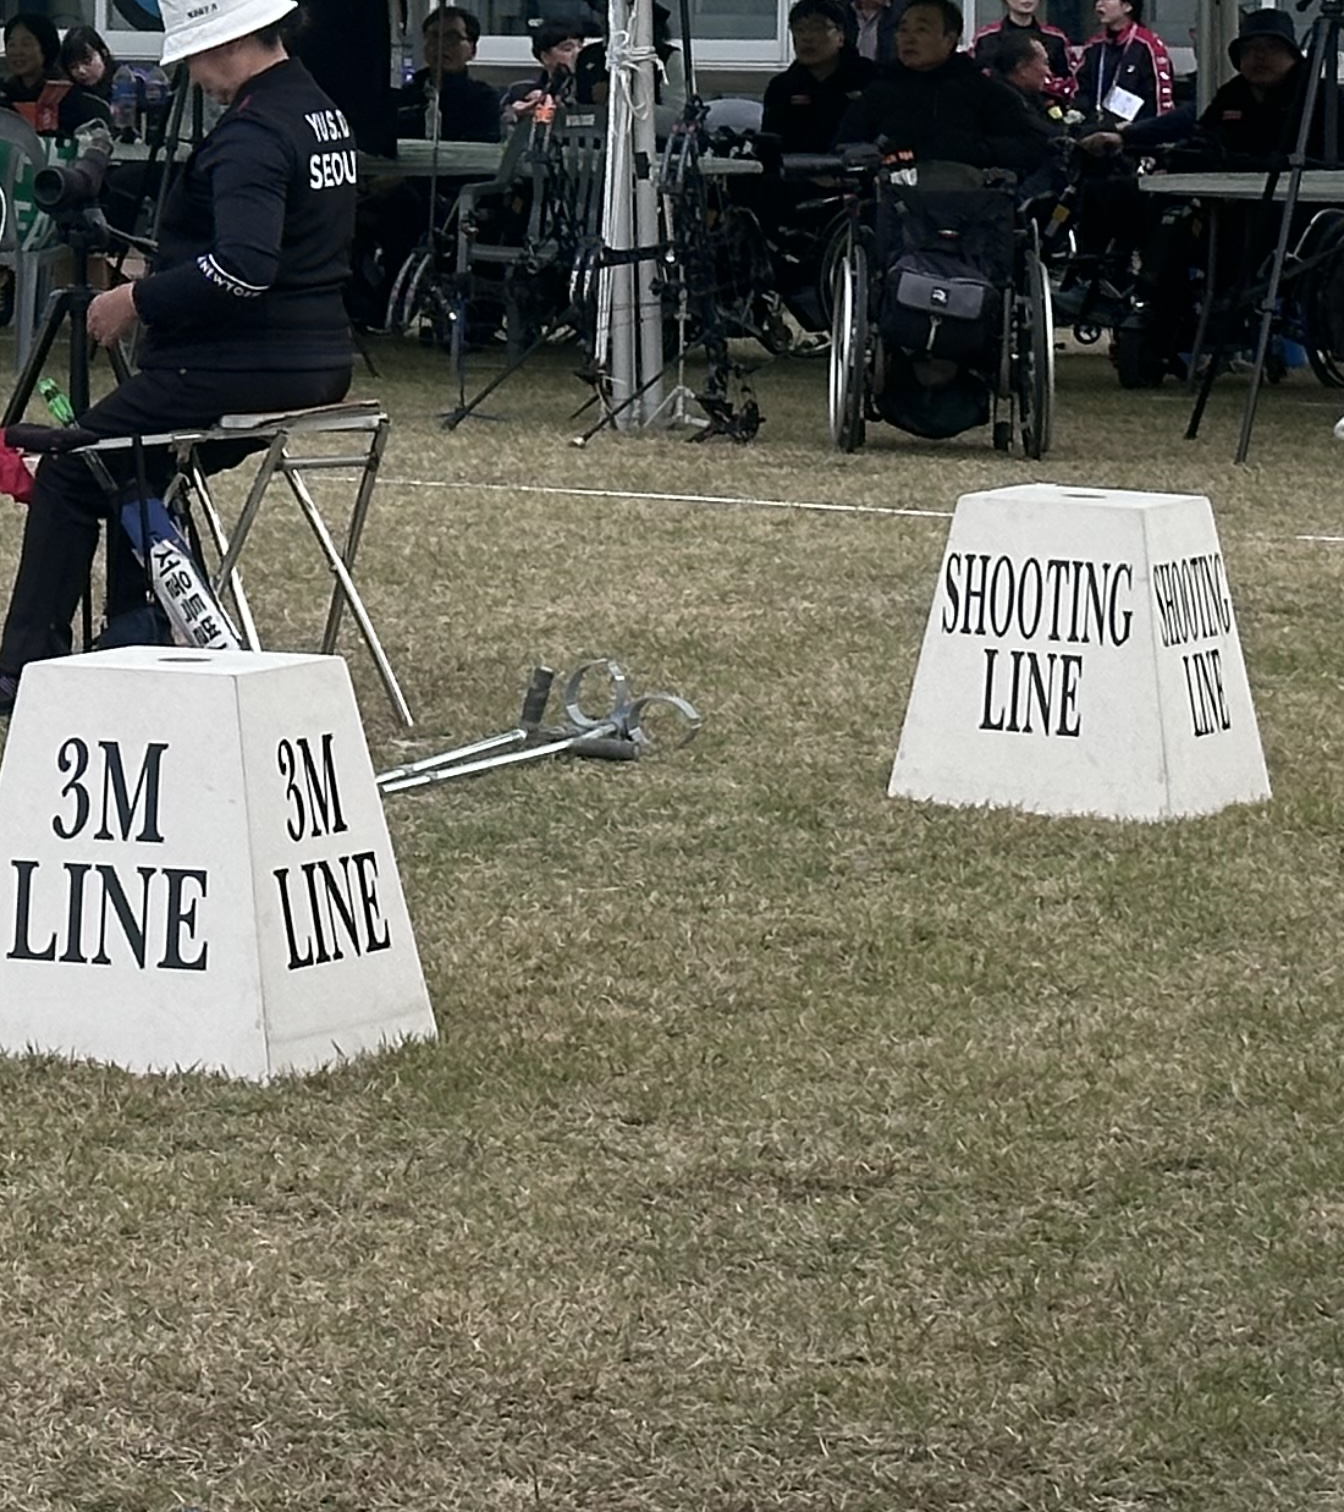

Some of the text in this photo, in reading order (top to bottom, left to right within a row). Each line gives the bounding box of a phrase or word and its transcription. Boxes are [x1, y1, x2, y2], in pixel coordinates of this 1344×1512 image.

[309, 149, 357, 190] SEOU
[153, 548, 228, 650] 서울특별
[942, 552, 1133, 647] SHOOTING
[1153, 552, 1231, 648] SHOOTING
[978, 648, 1083, 737] LINE
[1182, 648, 1231, 738] LINE
[52, 736, 169, 844] 3M
[277, 732, 348, 843] 3M
[6, 859, 208, 971] LINE
[273, 851, 392, 971] LINE
